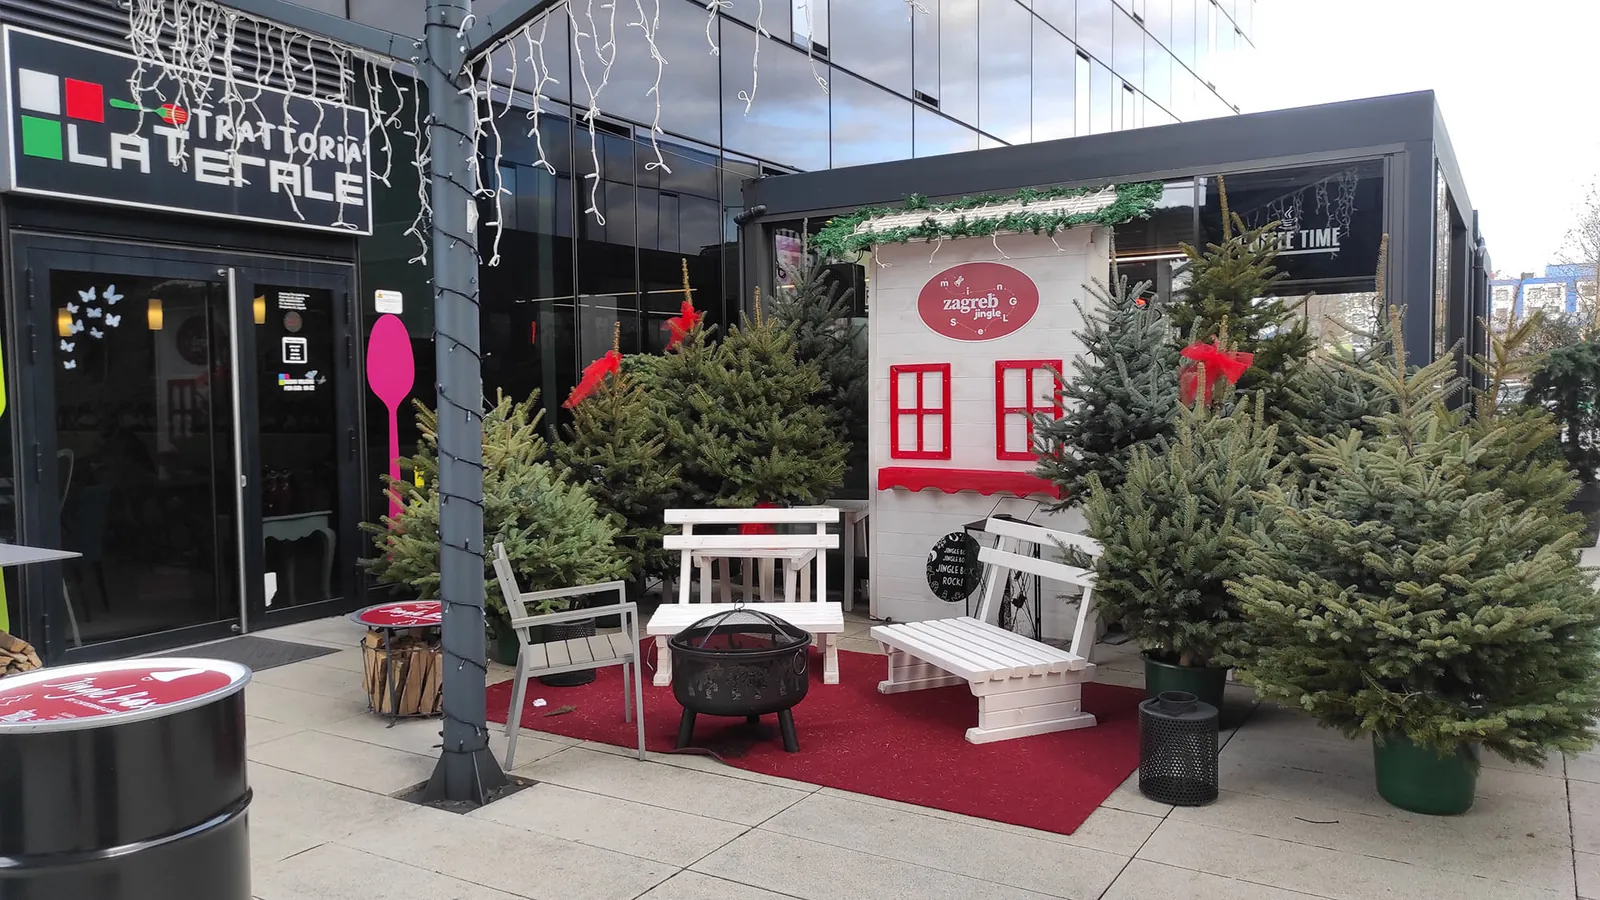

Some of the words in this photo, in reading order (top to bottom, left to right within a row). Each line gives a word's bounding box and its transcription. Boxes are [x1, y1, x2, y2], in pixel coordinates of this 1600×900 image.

[1300, 227, 1341, 249] TIME
[943, 293, 998, 313] zagreb
[974, 309, 1001, 320] jingle
[944, 547, 959, 555] JINGLE
[936, 564, 959, 574] JINGLE
[942, 577, 964, 586] ROCK!
